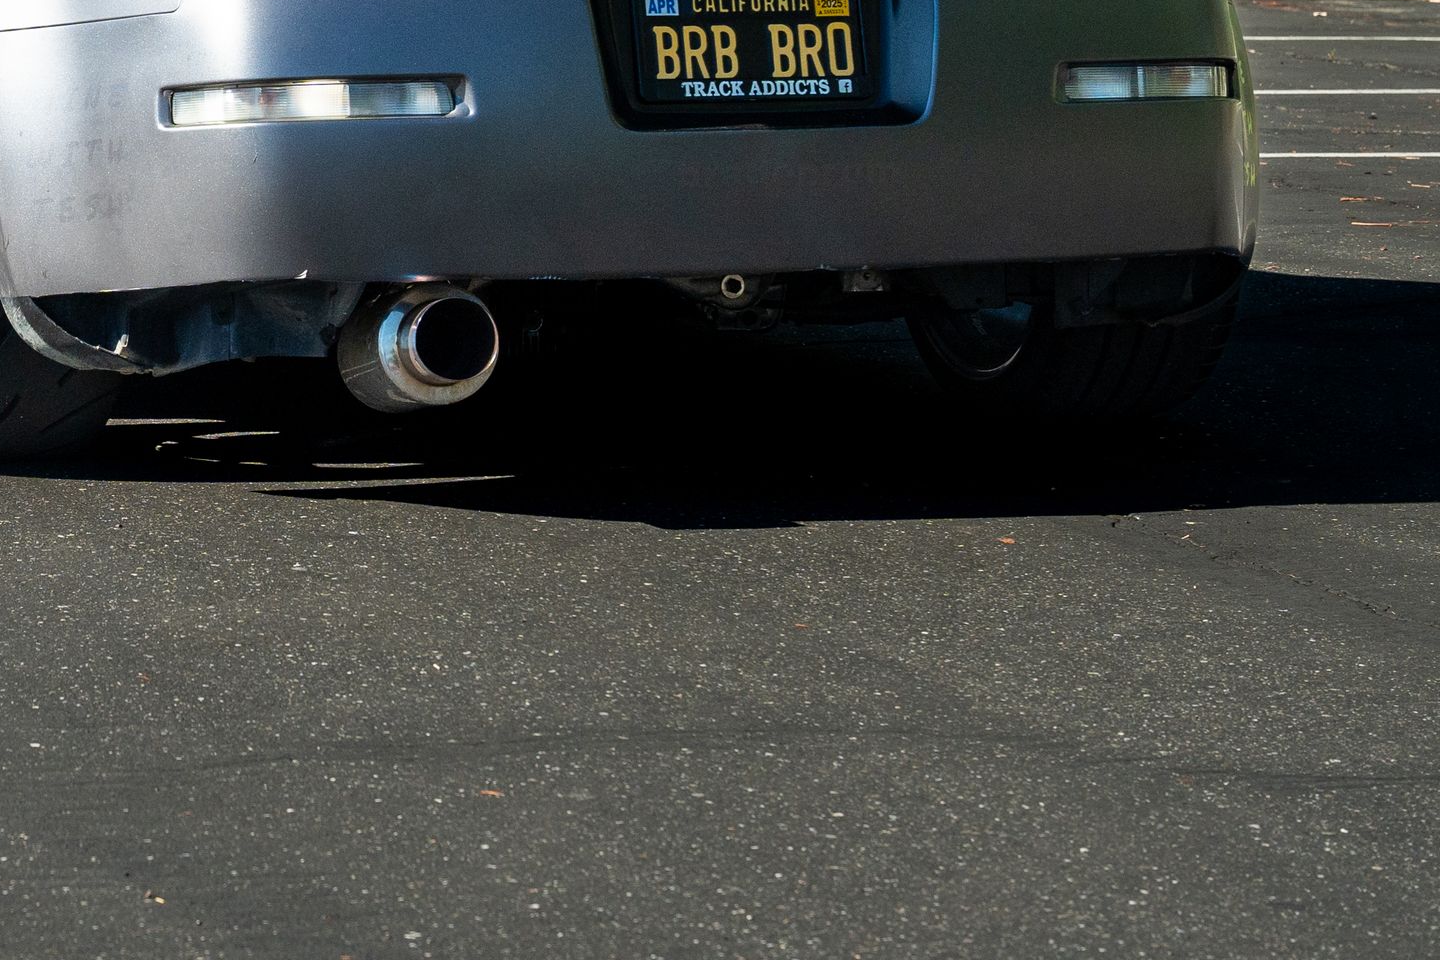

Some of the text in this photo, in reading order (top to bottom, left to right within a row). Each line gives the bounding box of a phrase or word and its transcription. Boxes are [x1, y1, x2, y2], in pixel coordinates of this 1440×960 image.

[652, 21, 855, 80] BRB BRO
[681, 80, 745, 97] TRACK
[748, 79, 830, 96] ADDICTS
